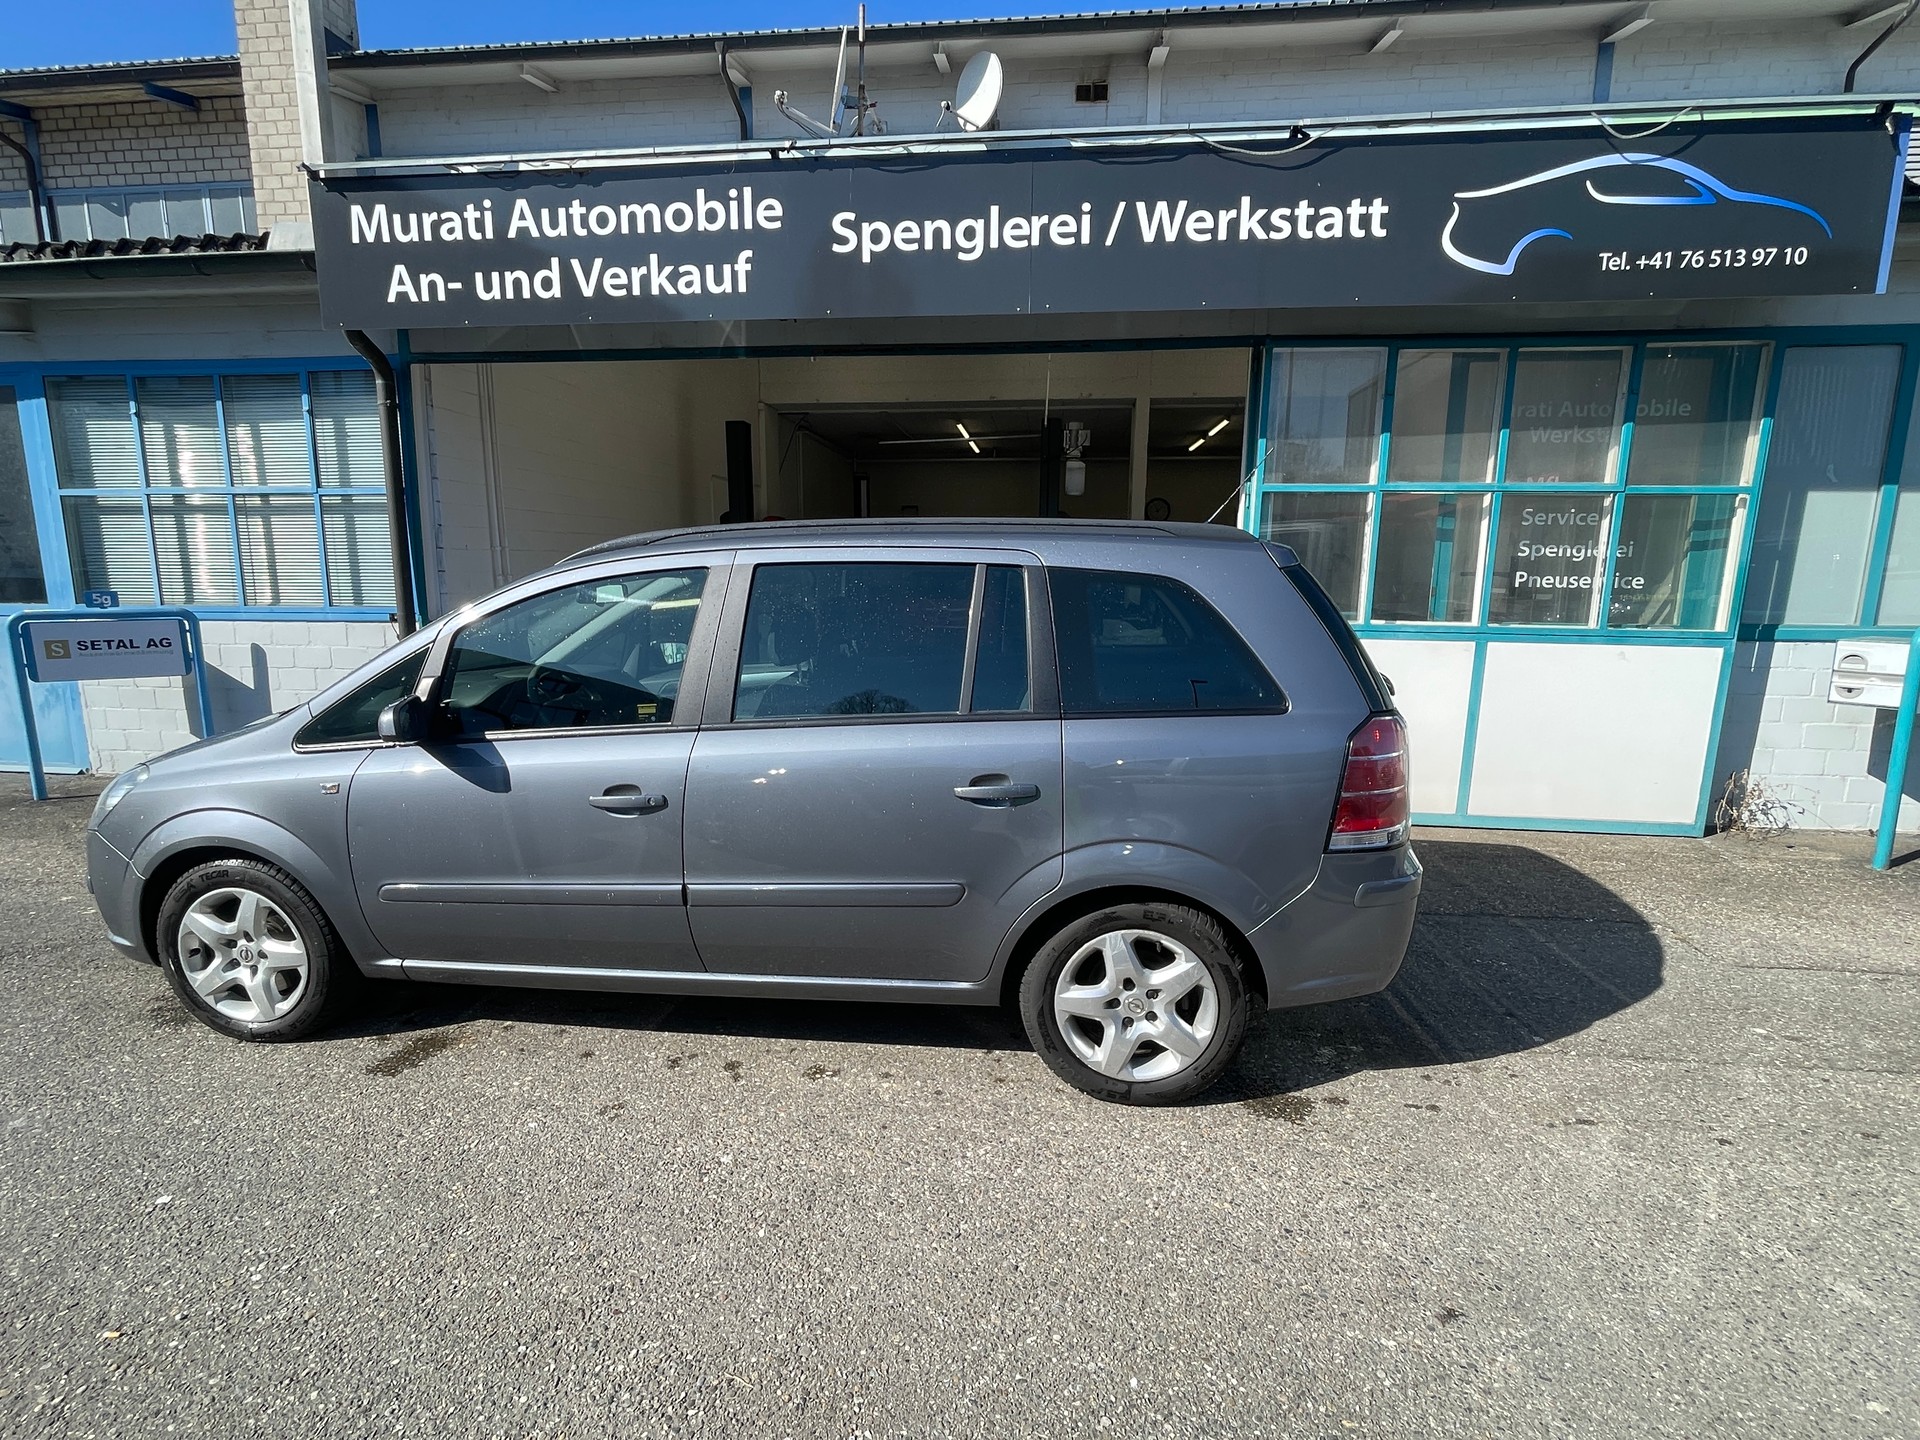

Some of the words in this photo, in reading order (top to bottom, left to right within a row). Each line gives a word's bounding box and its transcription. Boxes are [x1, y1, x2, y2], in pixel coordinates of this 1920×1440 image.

[351, 199, 493, 244] Murati
[508, 187, 784, 240] Automobile
[831, 202, 1092, 264] Spenglerei
[1105, 202, 1127, 247] /
[1136, 196, 1390, 243] Werkstatt
[1598, 252, 1631, 271] Tel.
[1636, 251, 1673, 270] +41
[1680, 250, 1705, 269] 76
[1709, 249, 1747, 268] 513
[1751, 248, 1778, 267] 97
[1783, 247, 1808, 266] 10
[387, 264, 463, 303] An-
[475, 257, 561, 301] und
[570, 250, 754, 298] Verkauf
[1558, 398, 1692, 418] Autoobile
[1521, 508, 1600, 526] Service
[1517, 540, 1634, 562] Spengleei
[1514, 571, 1645, 589] Pneuseice
[92, 593, 112, 607] 5g
[76, 638, 140, 651] SETAL
[146, 637, 173, 649] AG
[199, 869, 229, 882] TECAR
